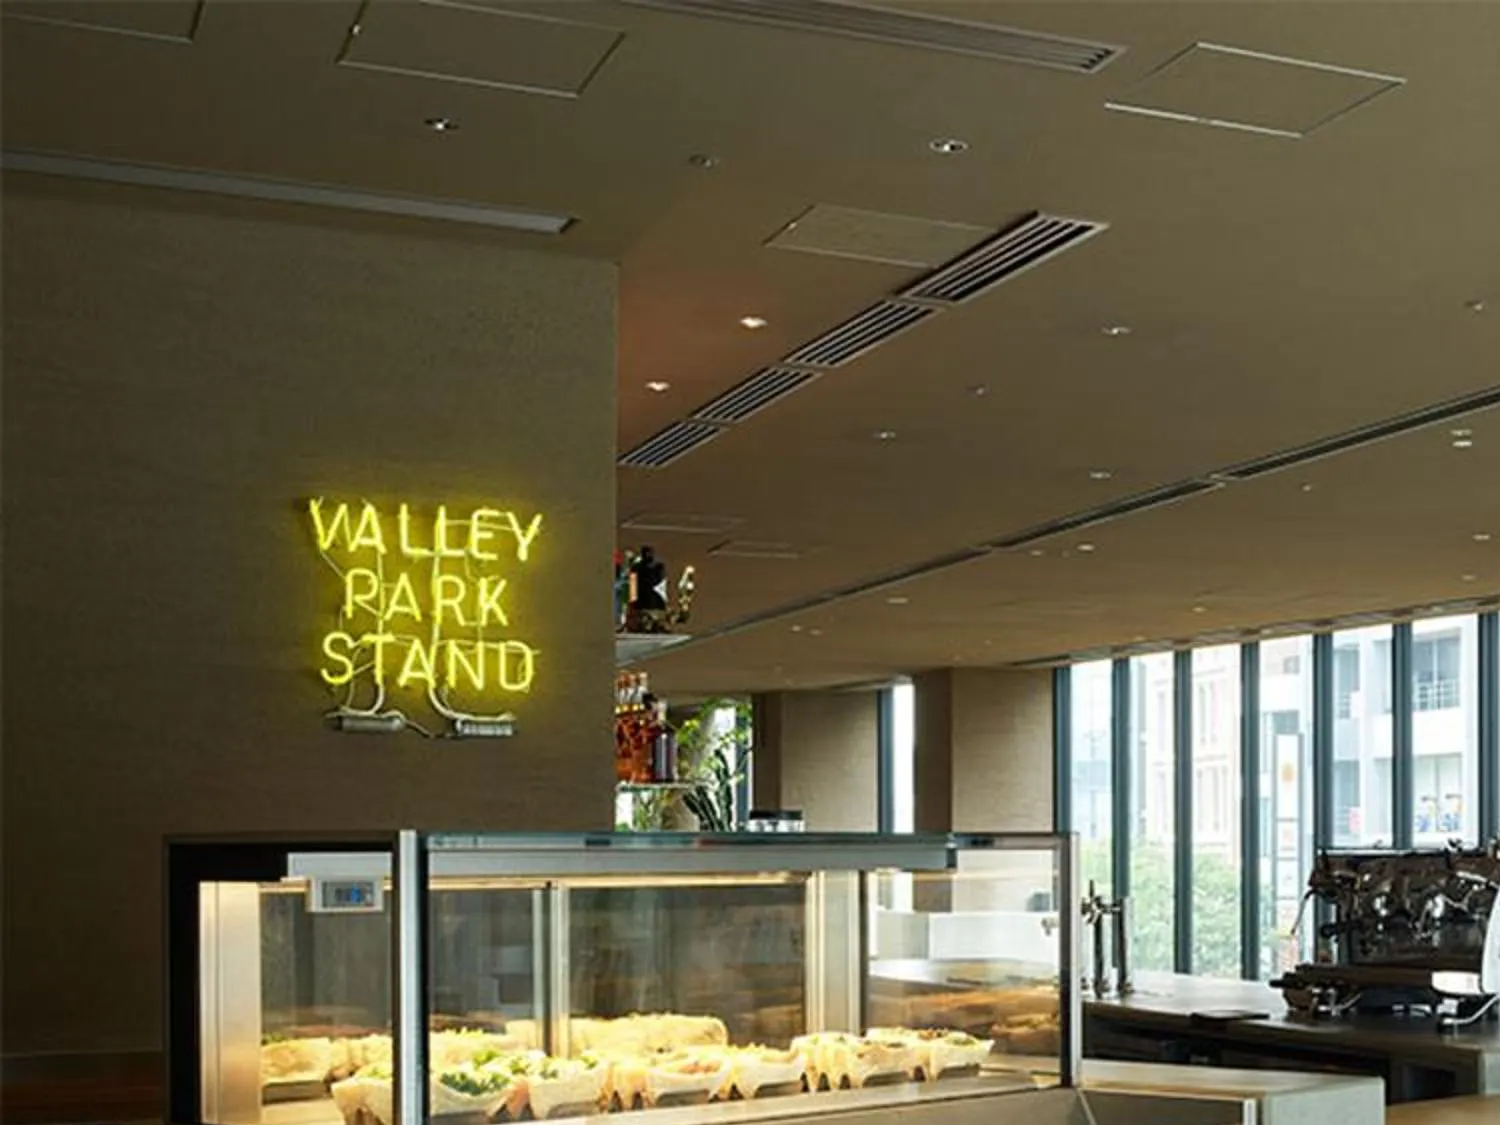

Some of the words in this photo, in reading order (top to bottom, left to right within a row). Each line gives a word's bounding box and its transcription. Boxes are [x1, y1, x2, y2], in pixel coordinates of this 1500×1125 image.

[309, 498, 543, 561] VALLEY
[346, 567, 509, 627] PARK
[320, 631, 534, 691] STAND
